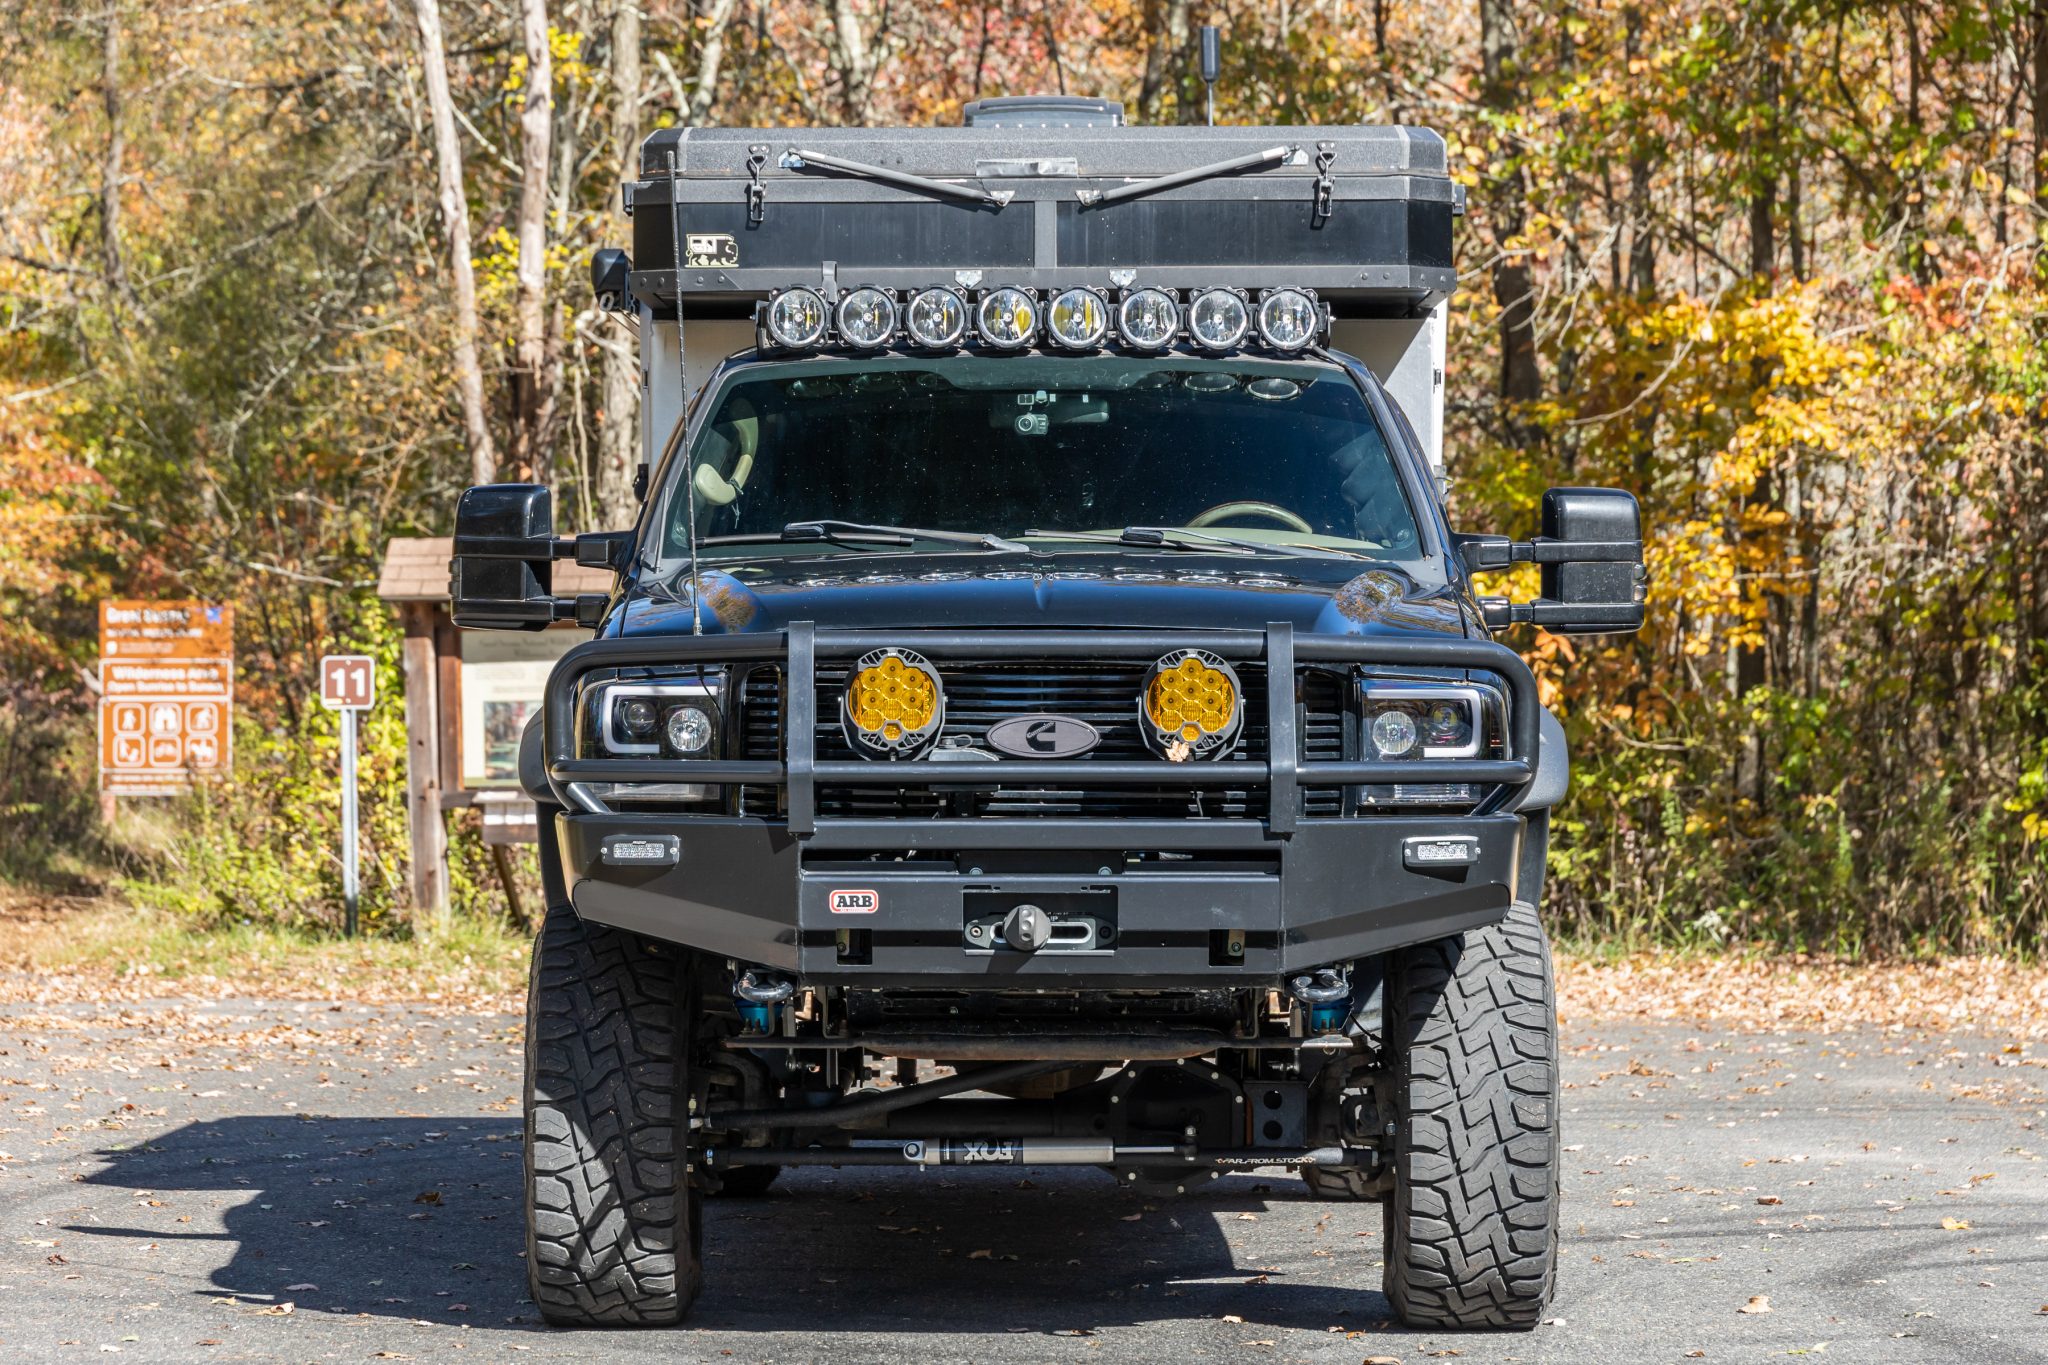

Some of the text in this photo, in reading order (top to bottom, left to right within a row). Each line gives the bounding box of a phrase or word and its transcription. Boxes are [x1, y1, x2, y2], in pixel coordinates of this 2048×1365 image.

[330, 668, 365, 697] 11
[836, 895, 873, 908] ARB
[963, 1141, 1014, 1161] FOX
